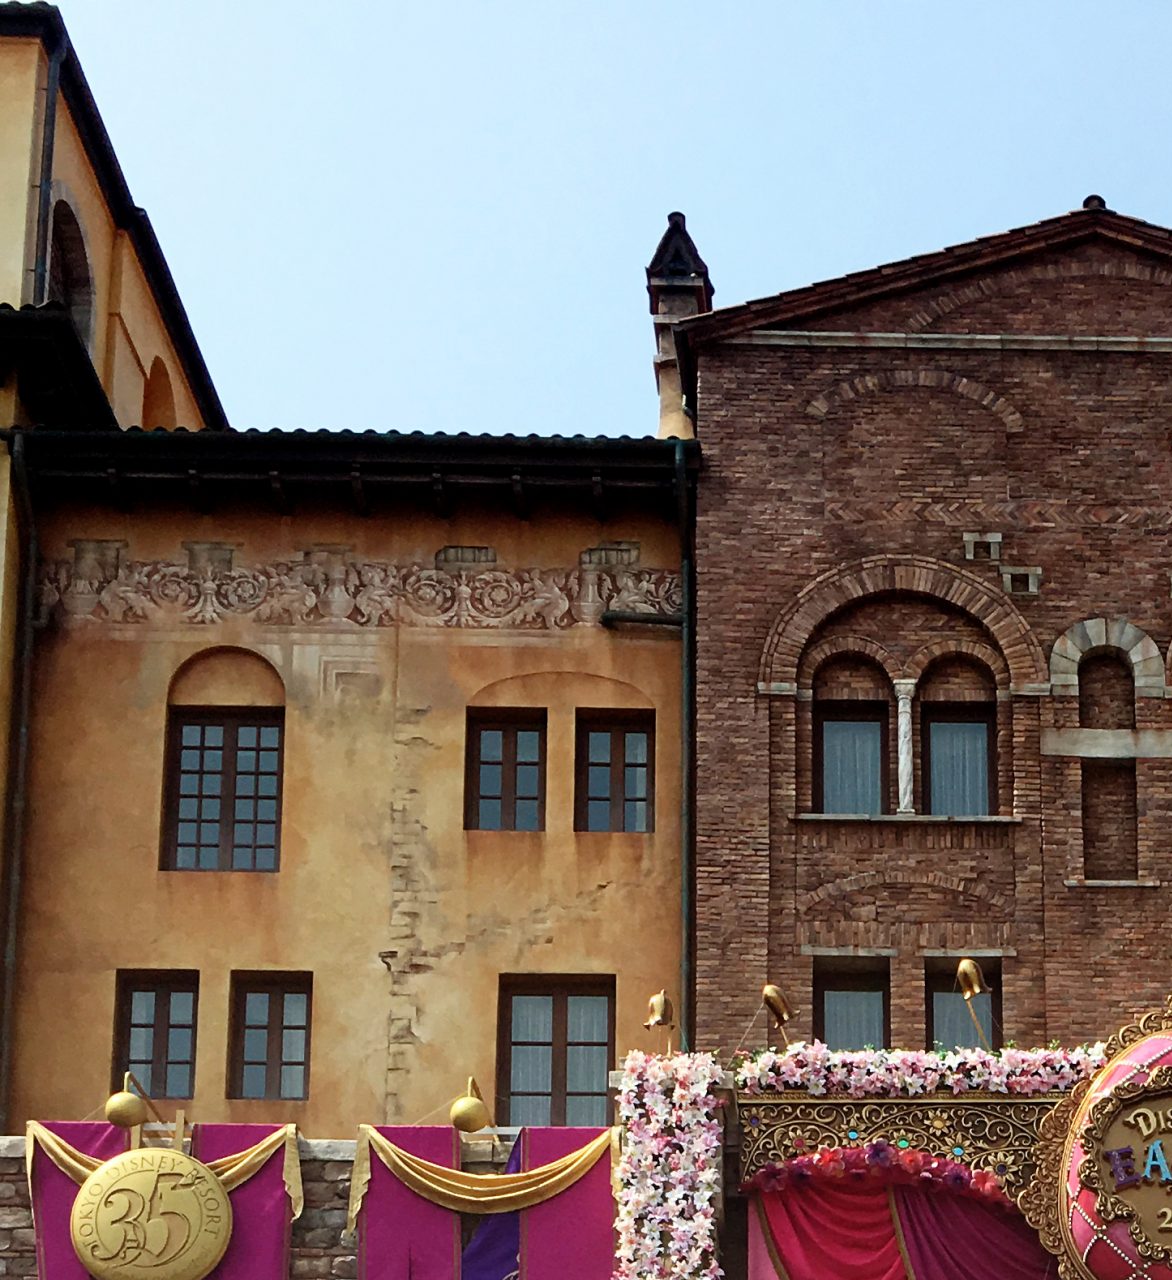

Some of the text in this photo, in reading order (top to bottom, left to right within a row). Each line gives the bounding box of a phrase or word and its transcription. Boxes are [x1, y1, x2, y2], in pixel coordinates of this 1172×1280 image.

[79, 1155, 222, 1249] TOKYO DISNEY RESORT
[91, 1172, 200, 1268] 35
